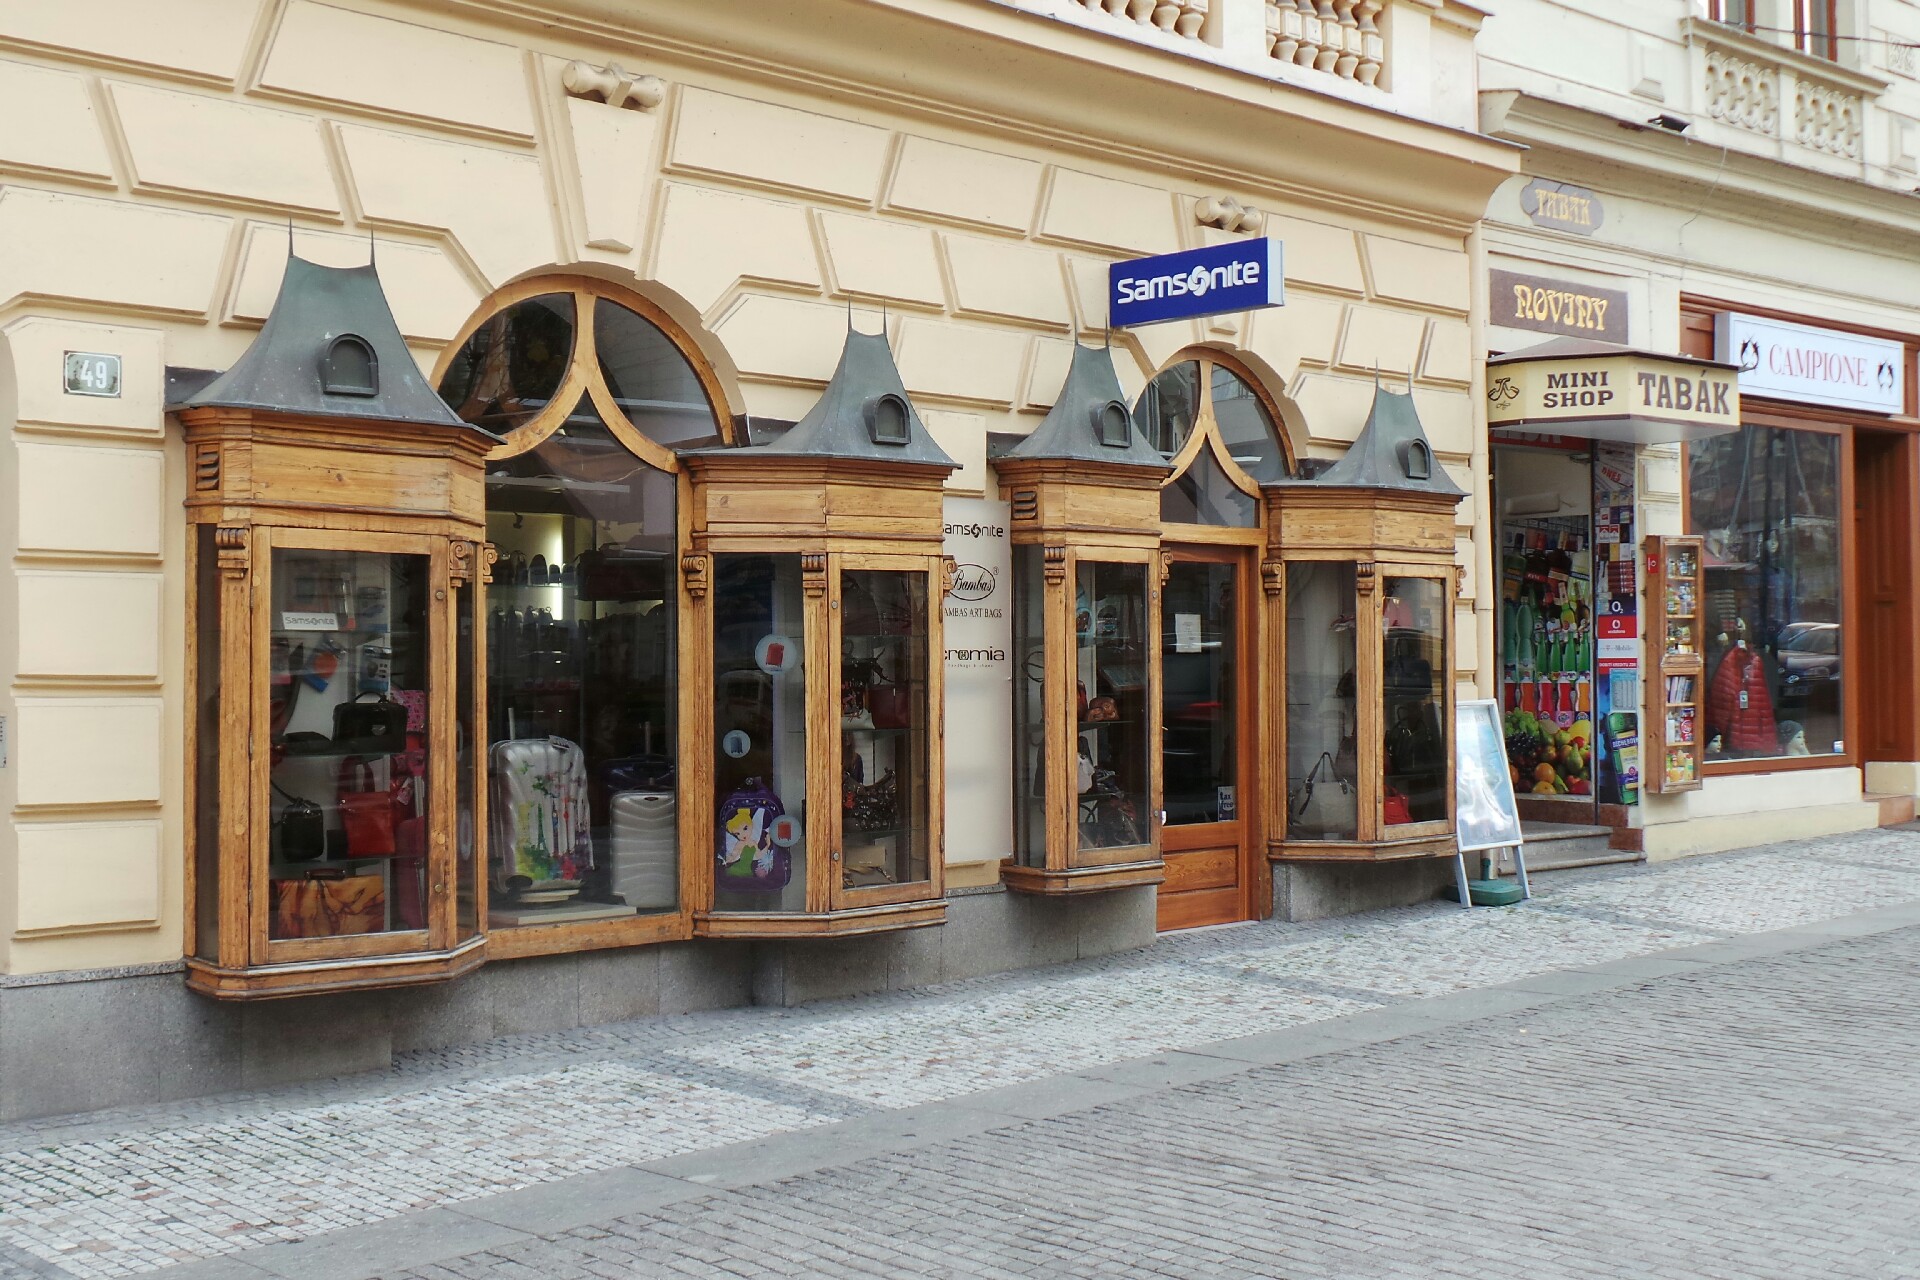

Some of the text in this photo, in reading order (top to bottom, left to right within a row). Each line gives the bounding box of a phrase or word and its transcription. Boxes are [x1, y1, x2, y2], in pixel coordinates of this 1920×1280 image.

[1117, 261, 1260, 304] Samsonite
[1513, 284, 1609, 331] NOVINY
[1769, 344, 1868, 387] CAMPIONE
[80, 360, 107, 389] 49
[1547, 371, 1609, 388] MINI
[1543, 390, 1614, 408] SHOP
[1638, 370, 1730, 415] TABÁK
[944, 523, 1004, 538] amsonite
[285, 616, 335, 626] Samsonite
[944, 607, 1003, 618] AMBAS ART BAGS
[944, 646, 1004, 661] romia
[1220, 791, 1231, 800] tax
[1221, 800, 1233, 808] free
